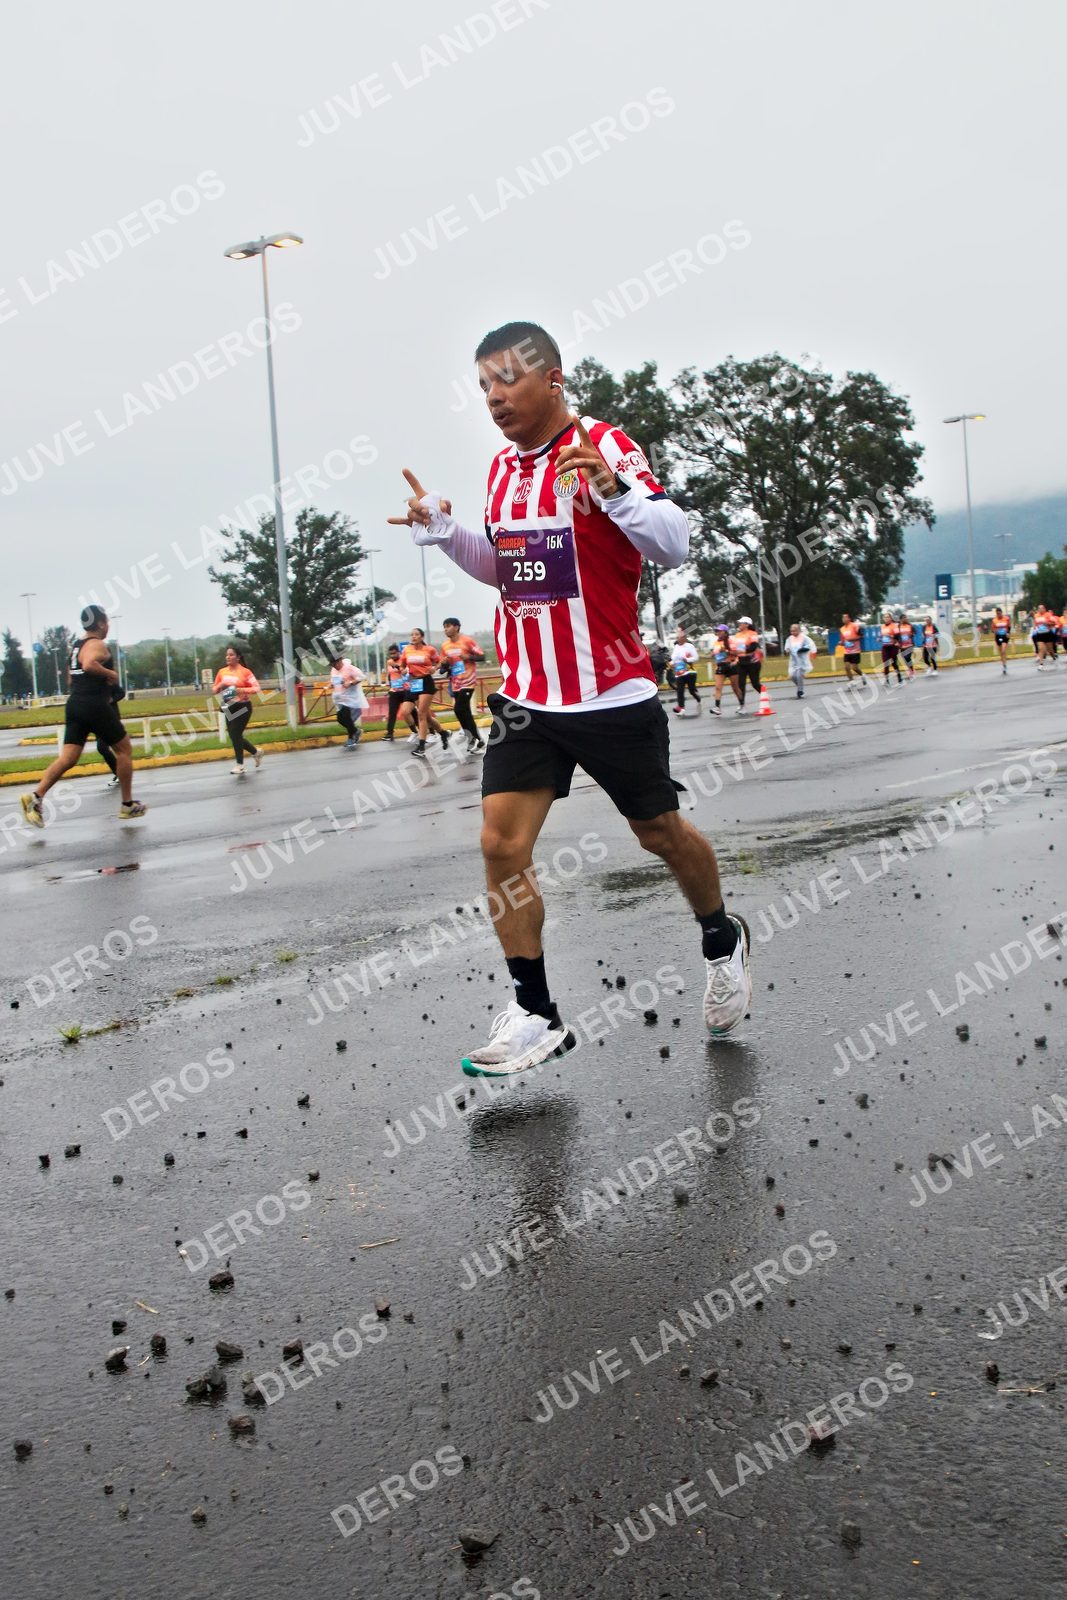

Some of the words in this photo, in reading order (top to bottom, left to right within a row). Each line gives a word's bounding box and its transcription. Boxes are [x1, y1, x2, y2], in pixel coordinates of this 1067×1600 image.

[515, 480, 532, 500] MG
[498, 536, 526, 549] CARRERA
[512, 560, 547, 582] 259
[938, 584, 948, 597] E
[522, 607, 542, 617] pago
